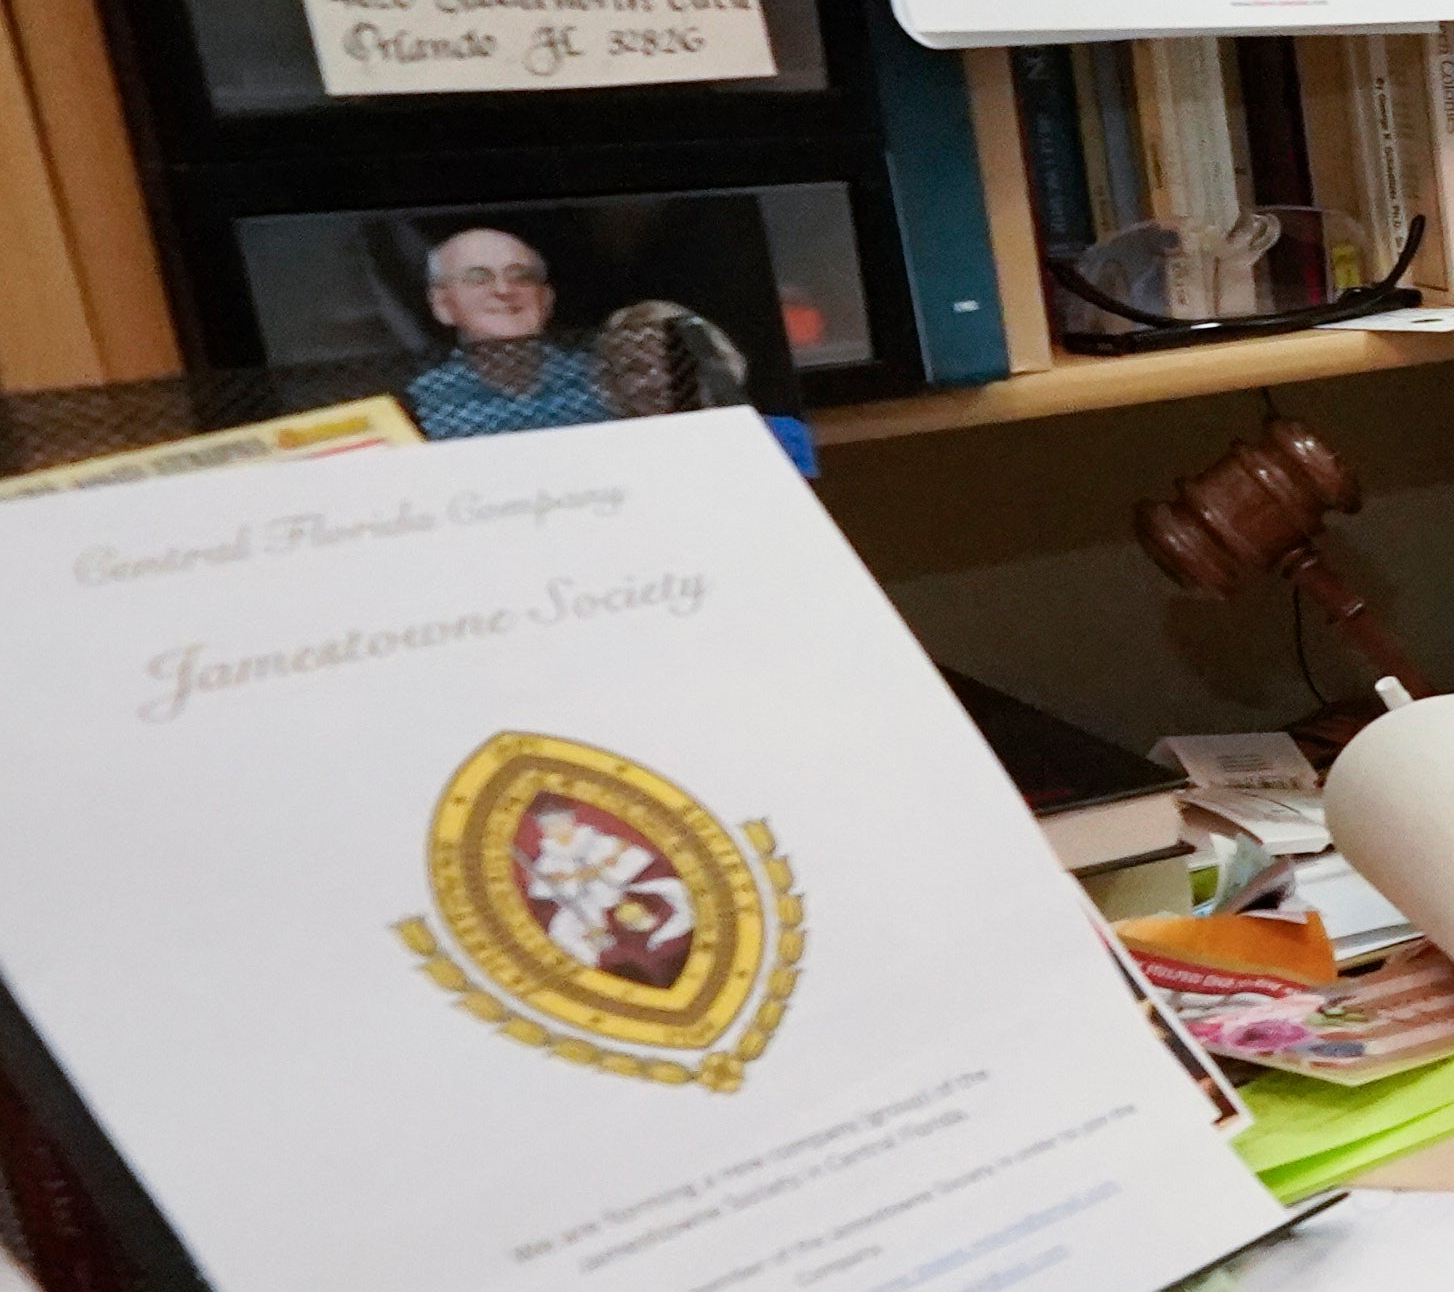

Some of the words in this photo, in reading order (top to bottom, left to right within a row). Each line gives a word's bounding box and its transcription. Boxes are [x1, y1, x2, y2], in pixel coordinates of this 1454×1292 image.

[342, 20, 498, 65] Orlando
[72, 522, 252, 591] Central
[262, 498, 438, 560] Florida
[445, 482, 632, 528] Company
[137, 604, 513, 725] Jamestowne
[523, 567, 712, 627] Society
